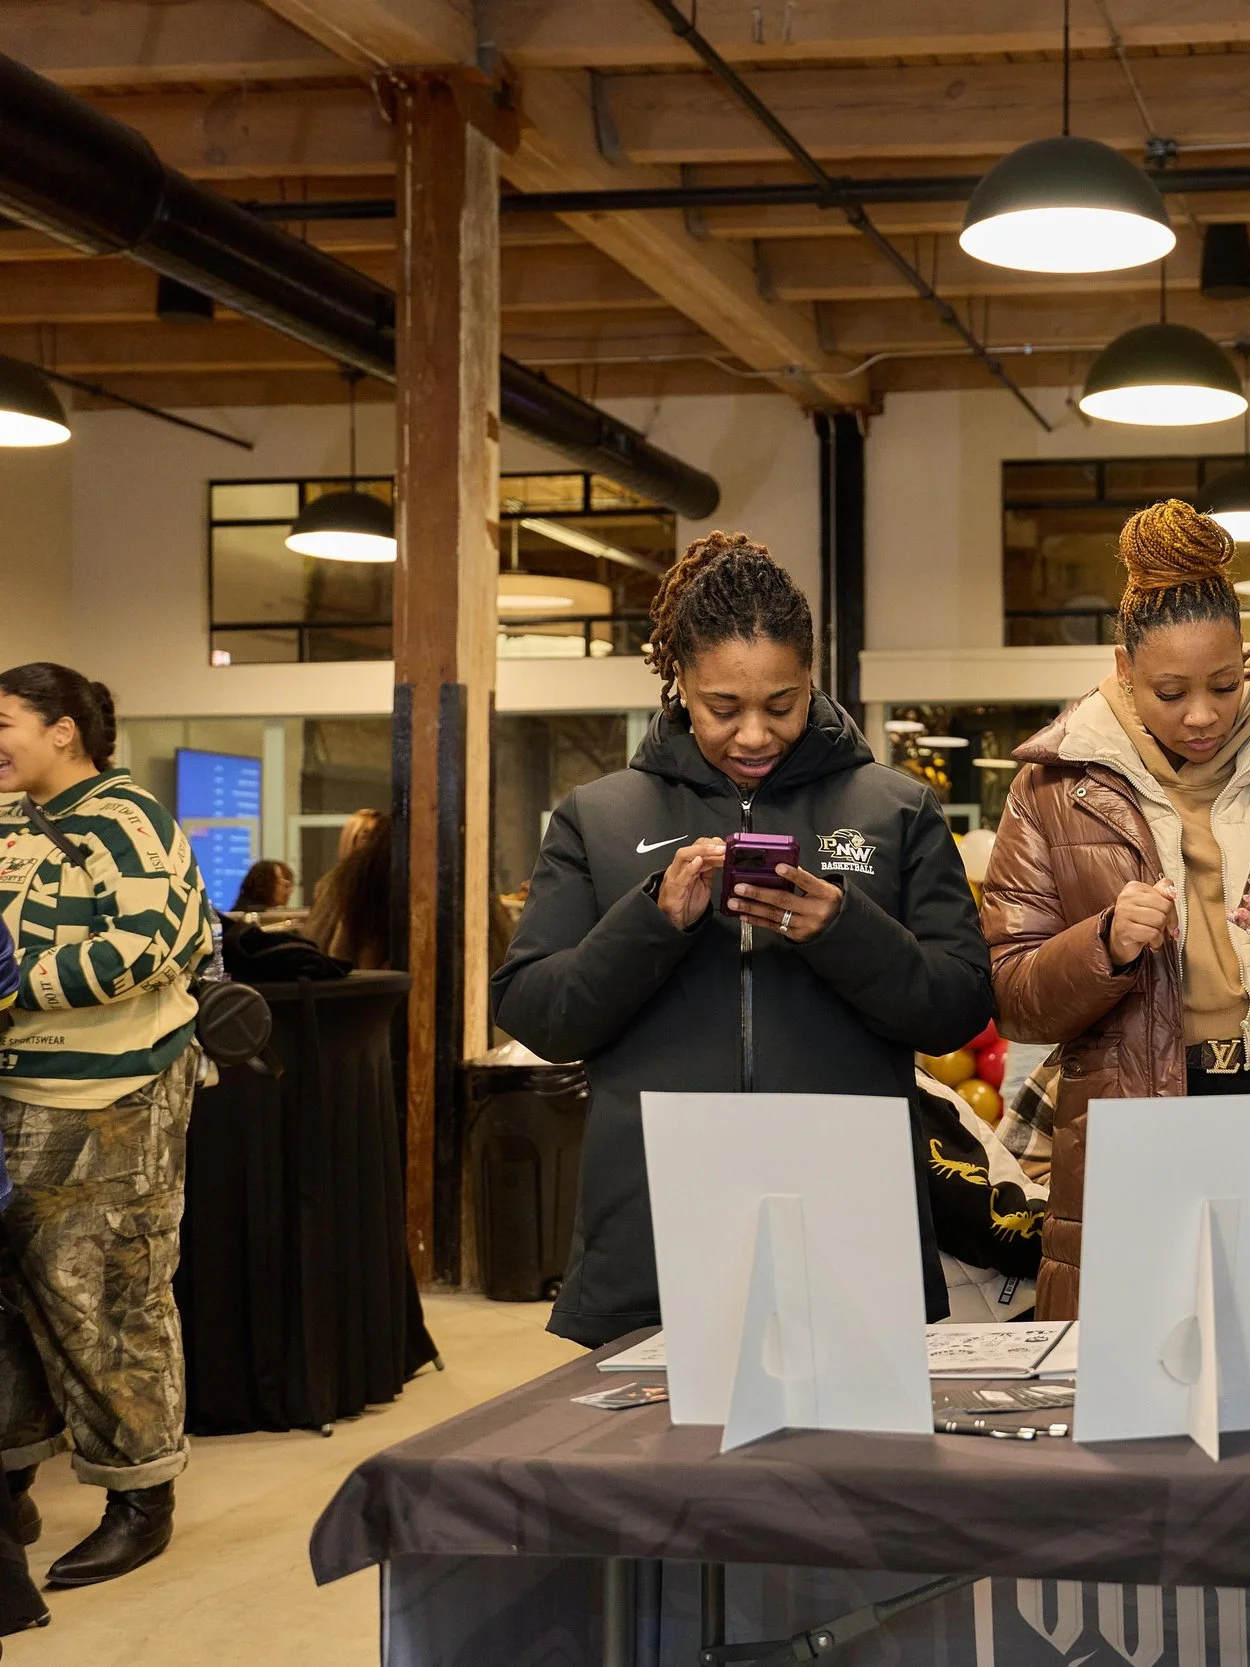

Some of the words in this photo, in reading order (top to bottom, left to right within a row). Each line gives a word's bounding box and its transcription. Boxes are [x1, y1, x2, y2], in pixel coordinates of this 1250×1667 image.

[823, 838, 871, 862] PNW
[821, 862, 875, 875] BASKETBALL
[9, 1036, 65, 1045] SPORTSWEAR
